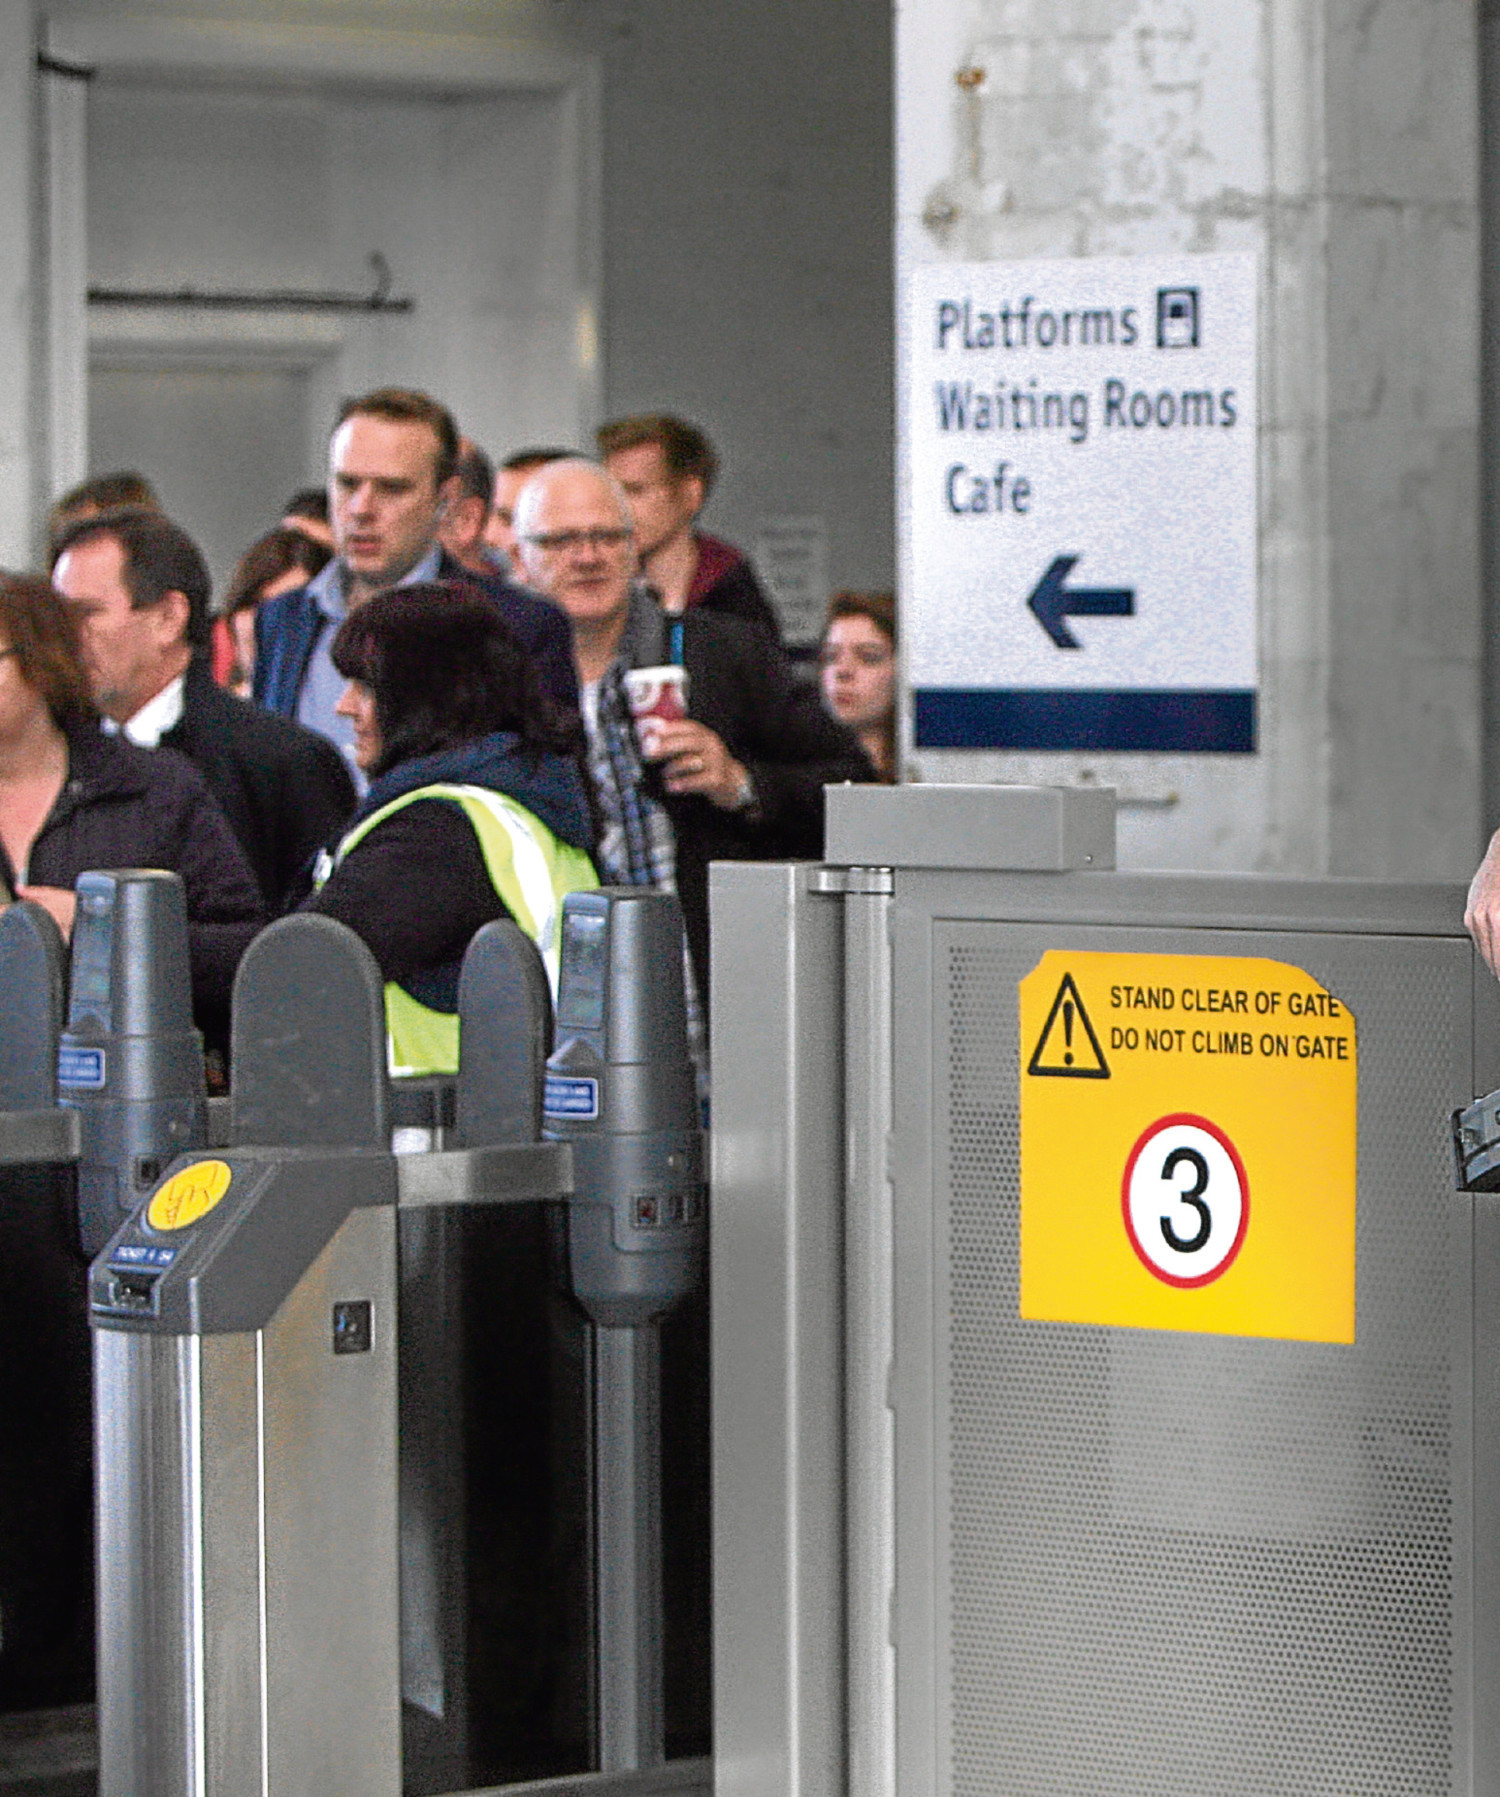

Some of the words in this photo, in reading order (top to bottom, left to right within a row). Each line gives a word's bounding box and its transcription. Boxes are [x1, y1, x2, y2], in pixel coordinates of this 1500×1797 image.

[938, 296, 1139, 350] Platforms
[938, 378, 1089, 445] Waiting
[1103, 378, 1237, 430] Rooms
[945, 462, 1031, 516] Cafe
[1110, 985, 1175, 1010] STAND
[1181, 988, 1249, 1014] CLEAR
[1254, 990, 1281, 1015] OF
[1288, 992, 1342, 1018] GATE
[1111, 1027, 1139, 1050] DO
[1145, 1029, 1186, 1052] NOT
[1192, 1030, 1253, 1056] CLIMB
[1259, 1033, 1289, 1057] ON
[1295, 1035, 1349, 1060] GATE
[1160, 1146, 1212, 1253] 3
